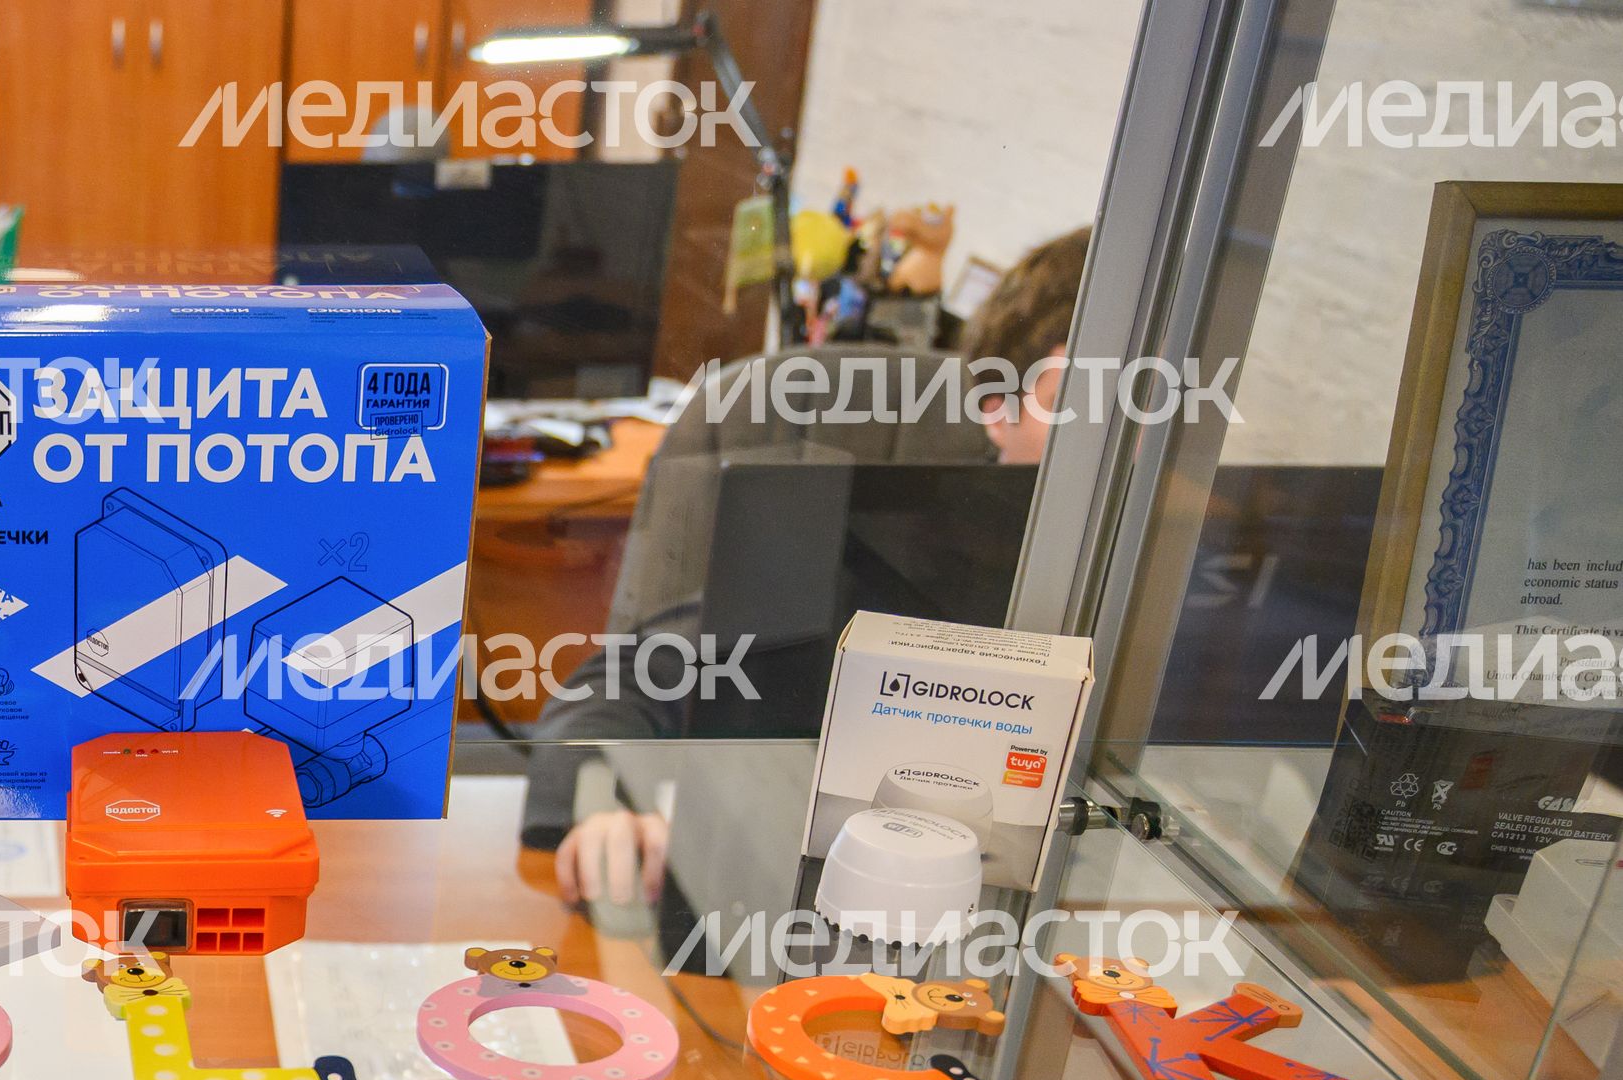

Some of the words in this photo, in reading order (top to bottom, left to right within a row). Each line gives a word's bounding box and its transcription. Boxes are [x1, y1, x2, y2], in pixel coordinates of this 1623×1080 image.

[367, 373, 379, 394] 4
[383, 372, 431, 396] ГОДА
[33, 368, 328, 429] ЗАЩИТА
[366, 399, 430, 409] ГАРАНТИЯ
[375, 414, 419, 426] ПРОВЕРЕНО
[33, 433, 127, 483] ОТ
[146, 433, 436, 483] ПОТОПА
[1527, 558, 1547, 570] has
[1553, 559, 1580, 570] been
[1524, 577, 1580, 587] economic
[1585, 579, 1618, 588] status
[1521, 593, 1563, 605] abroad.
[912, 680, 1035, 710] GIDROLOCK
[872, 702, 922, 720] Датчик
[926, 711, 991, 730] протечки
[996, 721, 1033, 735] воды
[1011, 745, 1038, 754] Powered
[1010, 756, 1041, 769] tuya
[912, 770, 980, 787] GIDROLOCK
[1381, 809, 1411, 817] CAUTION
[1498, 813, 1523, 821] VALVE
[1524, 816, 1572, 827] REGULATED
[1494, 822, 1527, 831] SEALED
[1528, 826, 1572, 836] LEAD-ACID
[1574, 831, 1612, 840] BATTERY
